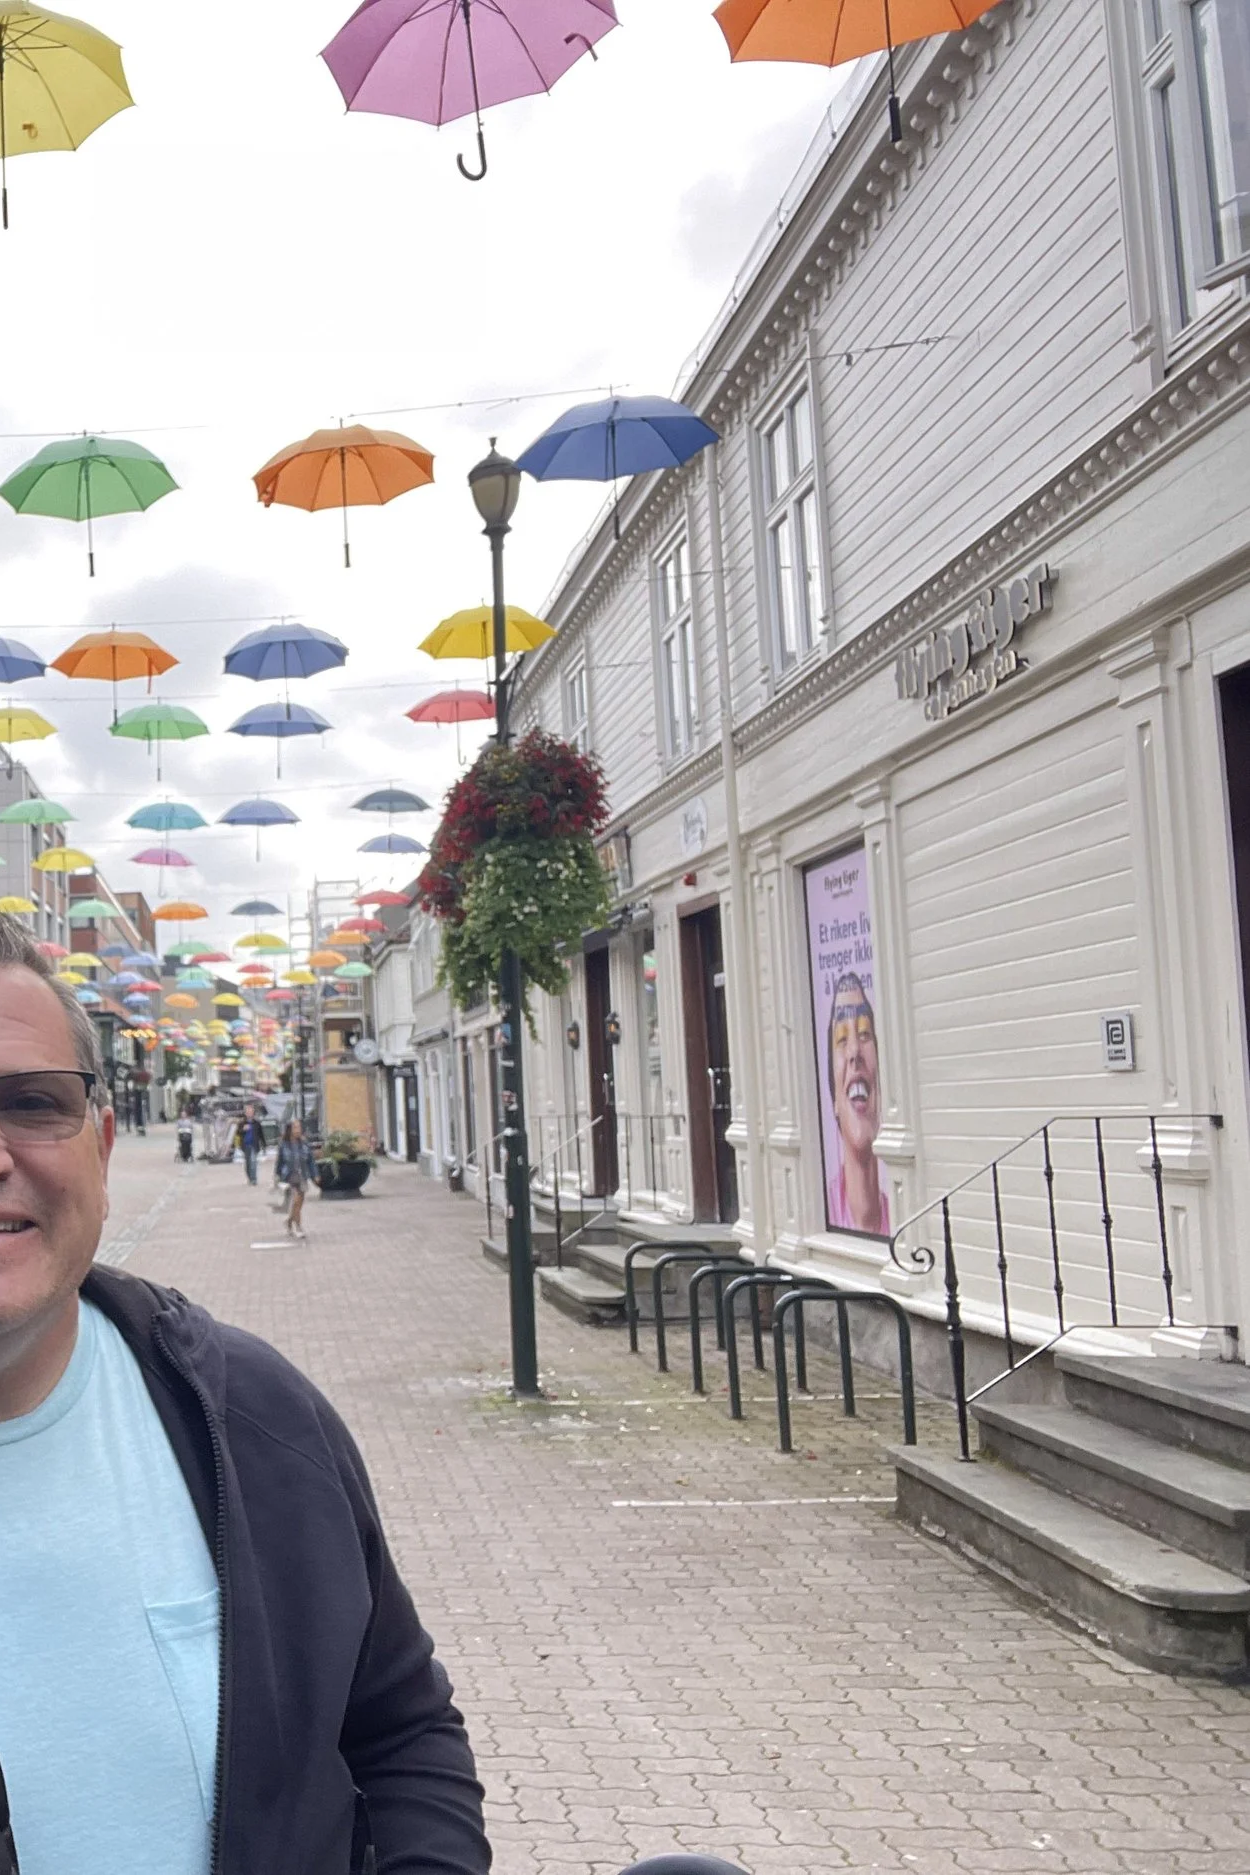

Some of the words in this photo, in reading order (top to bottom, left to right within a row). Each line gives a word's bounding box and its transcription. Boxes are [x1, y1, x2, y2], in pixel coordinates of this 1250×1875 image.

[967, 562, 1051, 658] tiger
[819, 923, 829, 944] Et
[830, 918, 857, 940] rikere
[859, 911, 871, 934] liv
[819, 949, 852, 972] trenger
